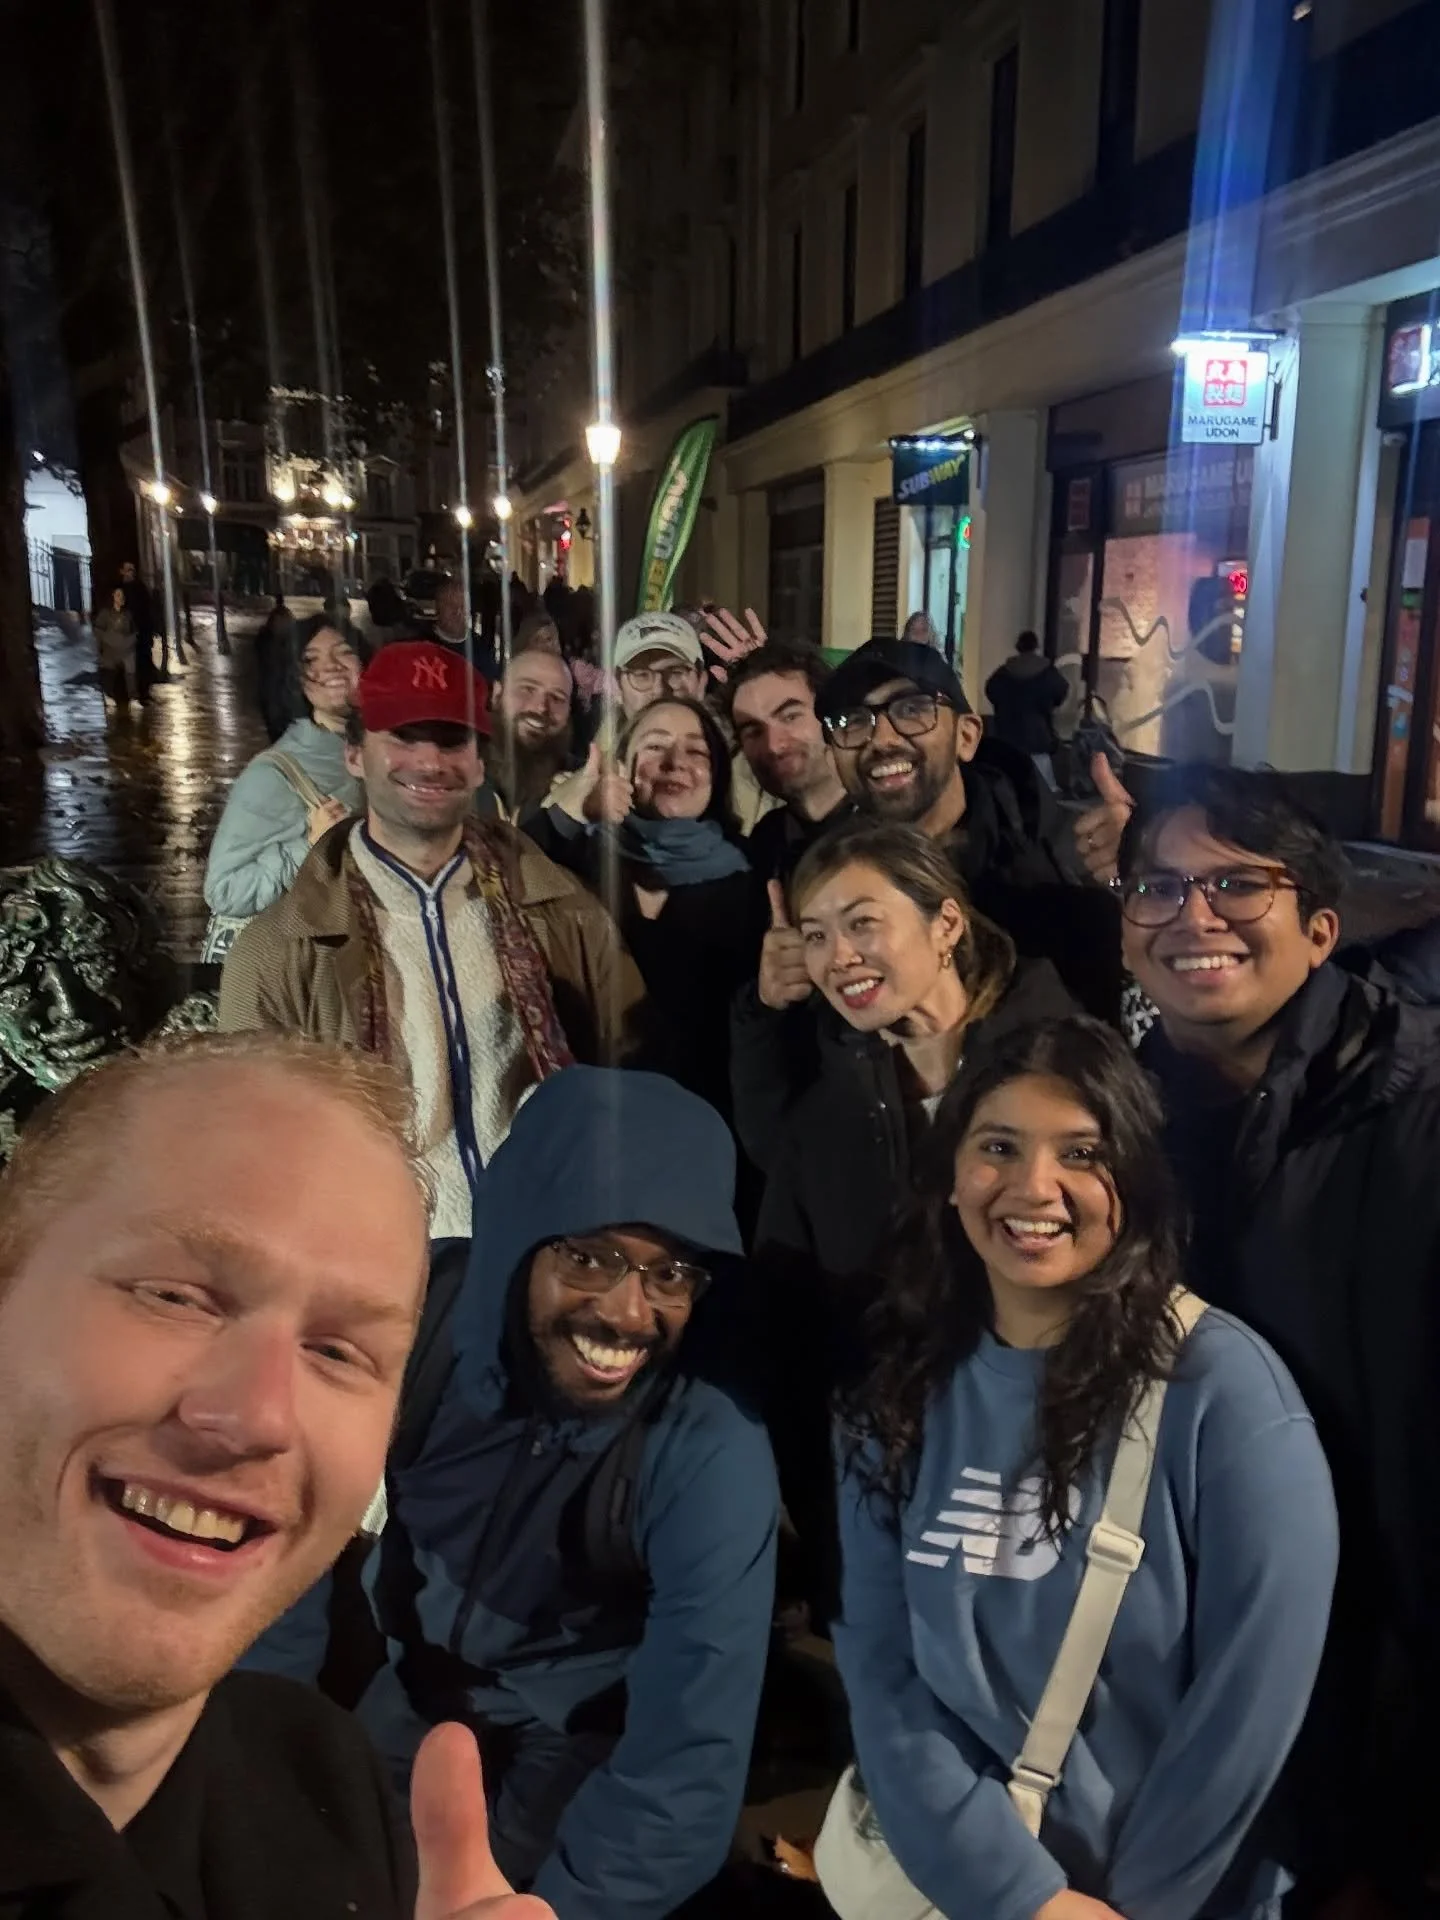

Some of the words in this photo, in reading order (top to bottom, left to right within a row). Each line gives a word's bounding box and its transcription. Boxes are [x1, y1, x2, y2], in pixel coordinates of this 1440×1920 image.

[1187, 415, 1258, 426] MARUGAME
[1206, 427, 1240, 438] UDON
[898, 453, 966, 499] SUBWAY
[644, 462, 688, 612] UBWAY
[412, 656, 448, 690] NY
